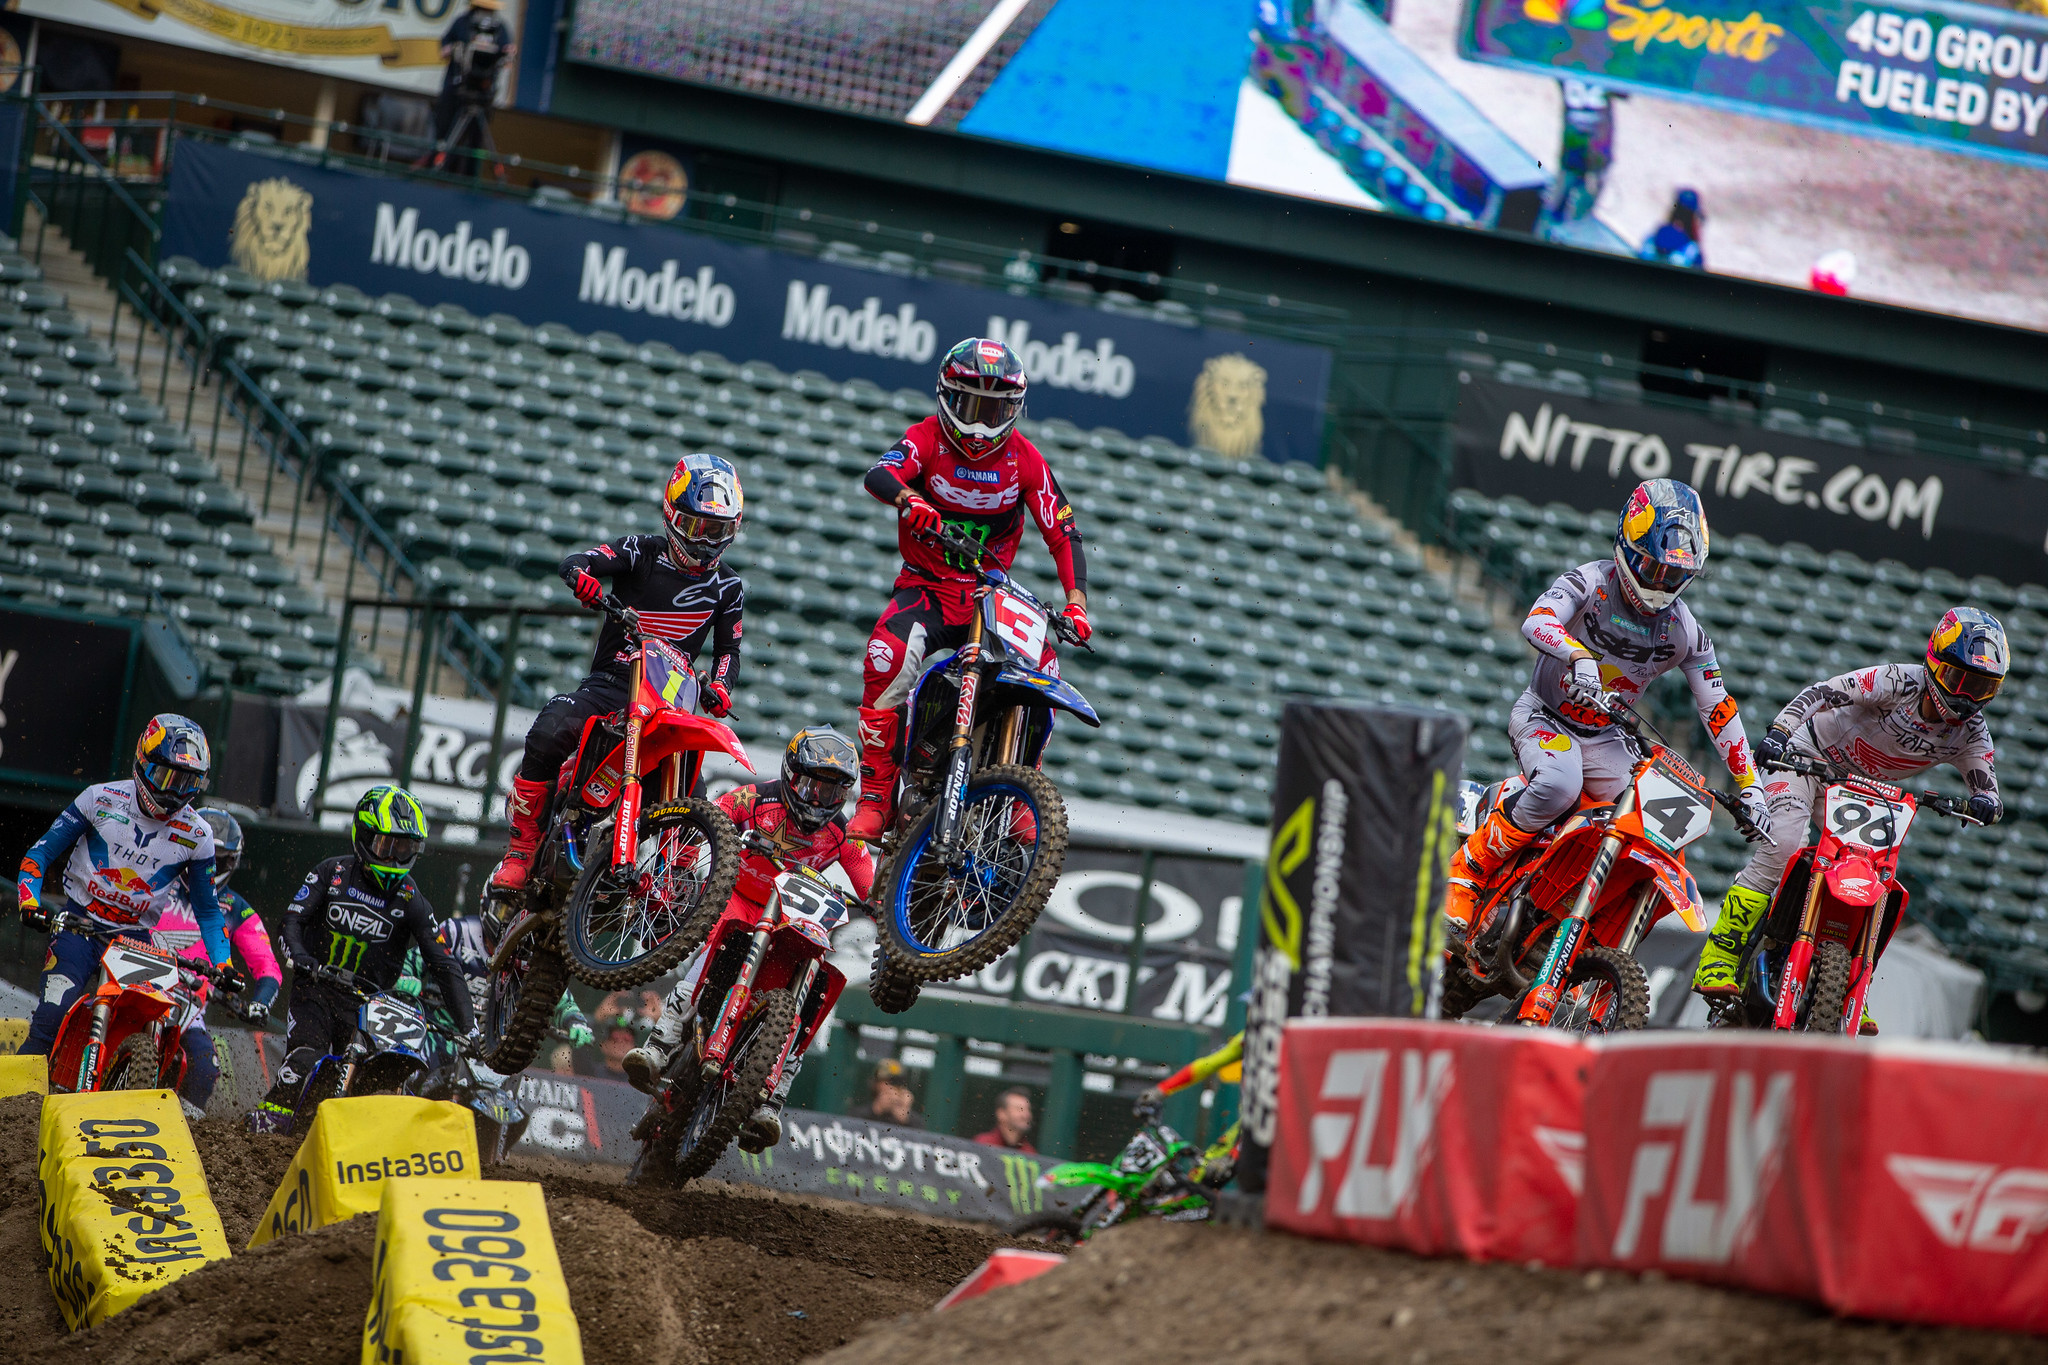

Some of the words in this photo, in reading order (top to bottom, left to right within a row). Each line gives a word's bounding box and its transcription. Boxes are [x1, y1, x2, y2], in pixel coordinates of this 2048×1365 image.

[1846, 10, 1933, 62] 450
[1836, 59, 1988, 126] FUELED
[1989, 78, 2048, 136] BY
[371, 202, 531, 289] Modelo
[579, 241, 736, 328] Modelo
[781, 279, 938, 364] Modelo
[965, 471, 999, 483] YAMAHA
[1500, 402, 1672, 479] NITTO
[1684, 443, 1943, 540] TIRE.COM
[996, 597, 1048, 662] 3
[661, 669, 686, 706] 1
[653, 807, 691, 818] DUNLOP
[950, 758, 967, 822] DUNLOP
[620, 800, 632, 852] DUNLOP
[1643, 796, 1700, 843] 4
[1830, 803, 1898, 847] 96
[356, 892, 385, 909] YAMAHA
[780, 877, 847, 932] 51
[1302, 778, 1347, 1017] CHAMPIONSHIP
[1840, 884, 1871, 897] HONDA
[118, 953, 174, 984] 7
[1538, 938, 1561, 981] MOTOREX
[1777, 961, 1793, 1017] DUNLOP
[369, 1006, 426, 1044] 32
[337, 1150, 465, 1185] Insta360
[787, 1120, 990, 1190] MONSTER
